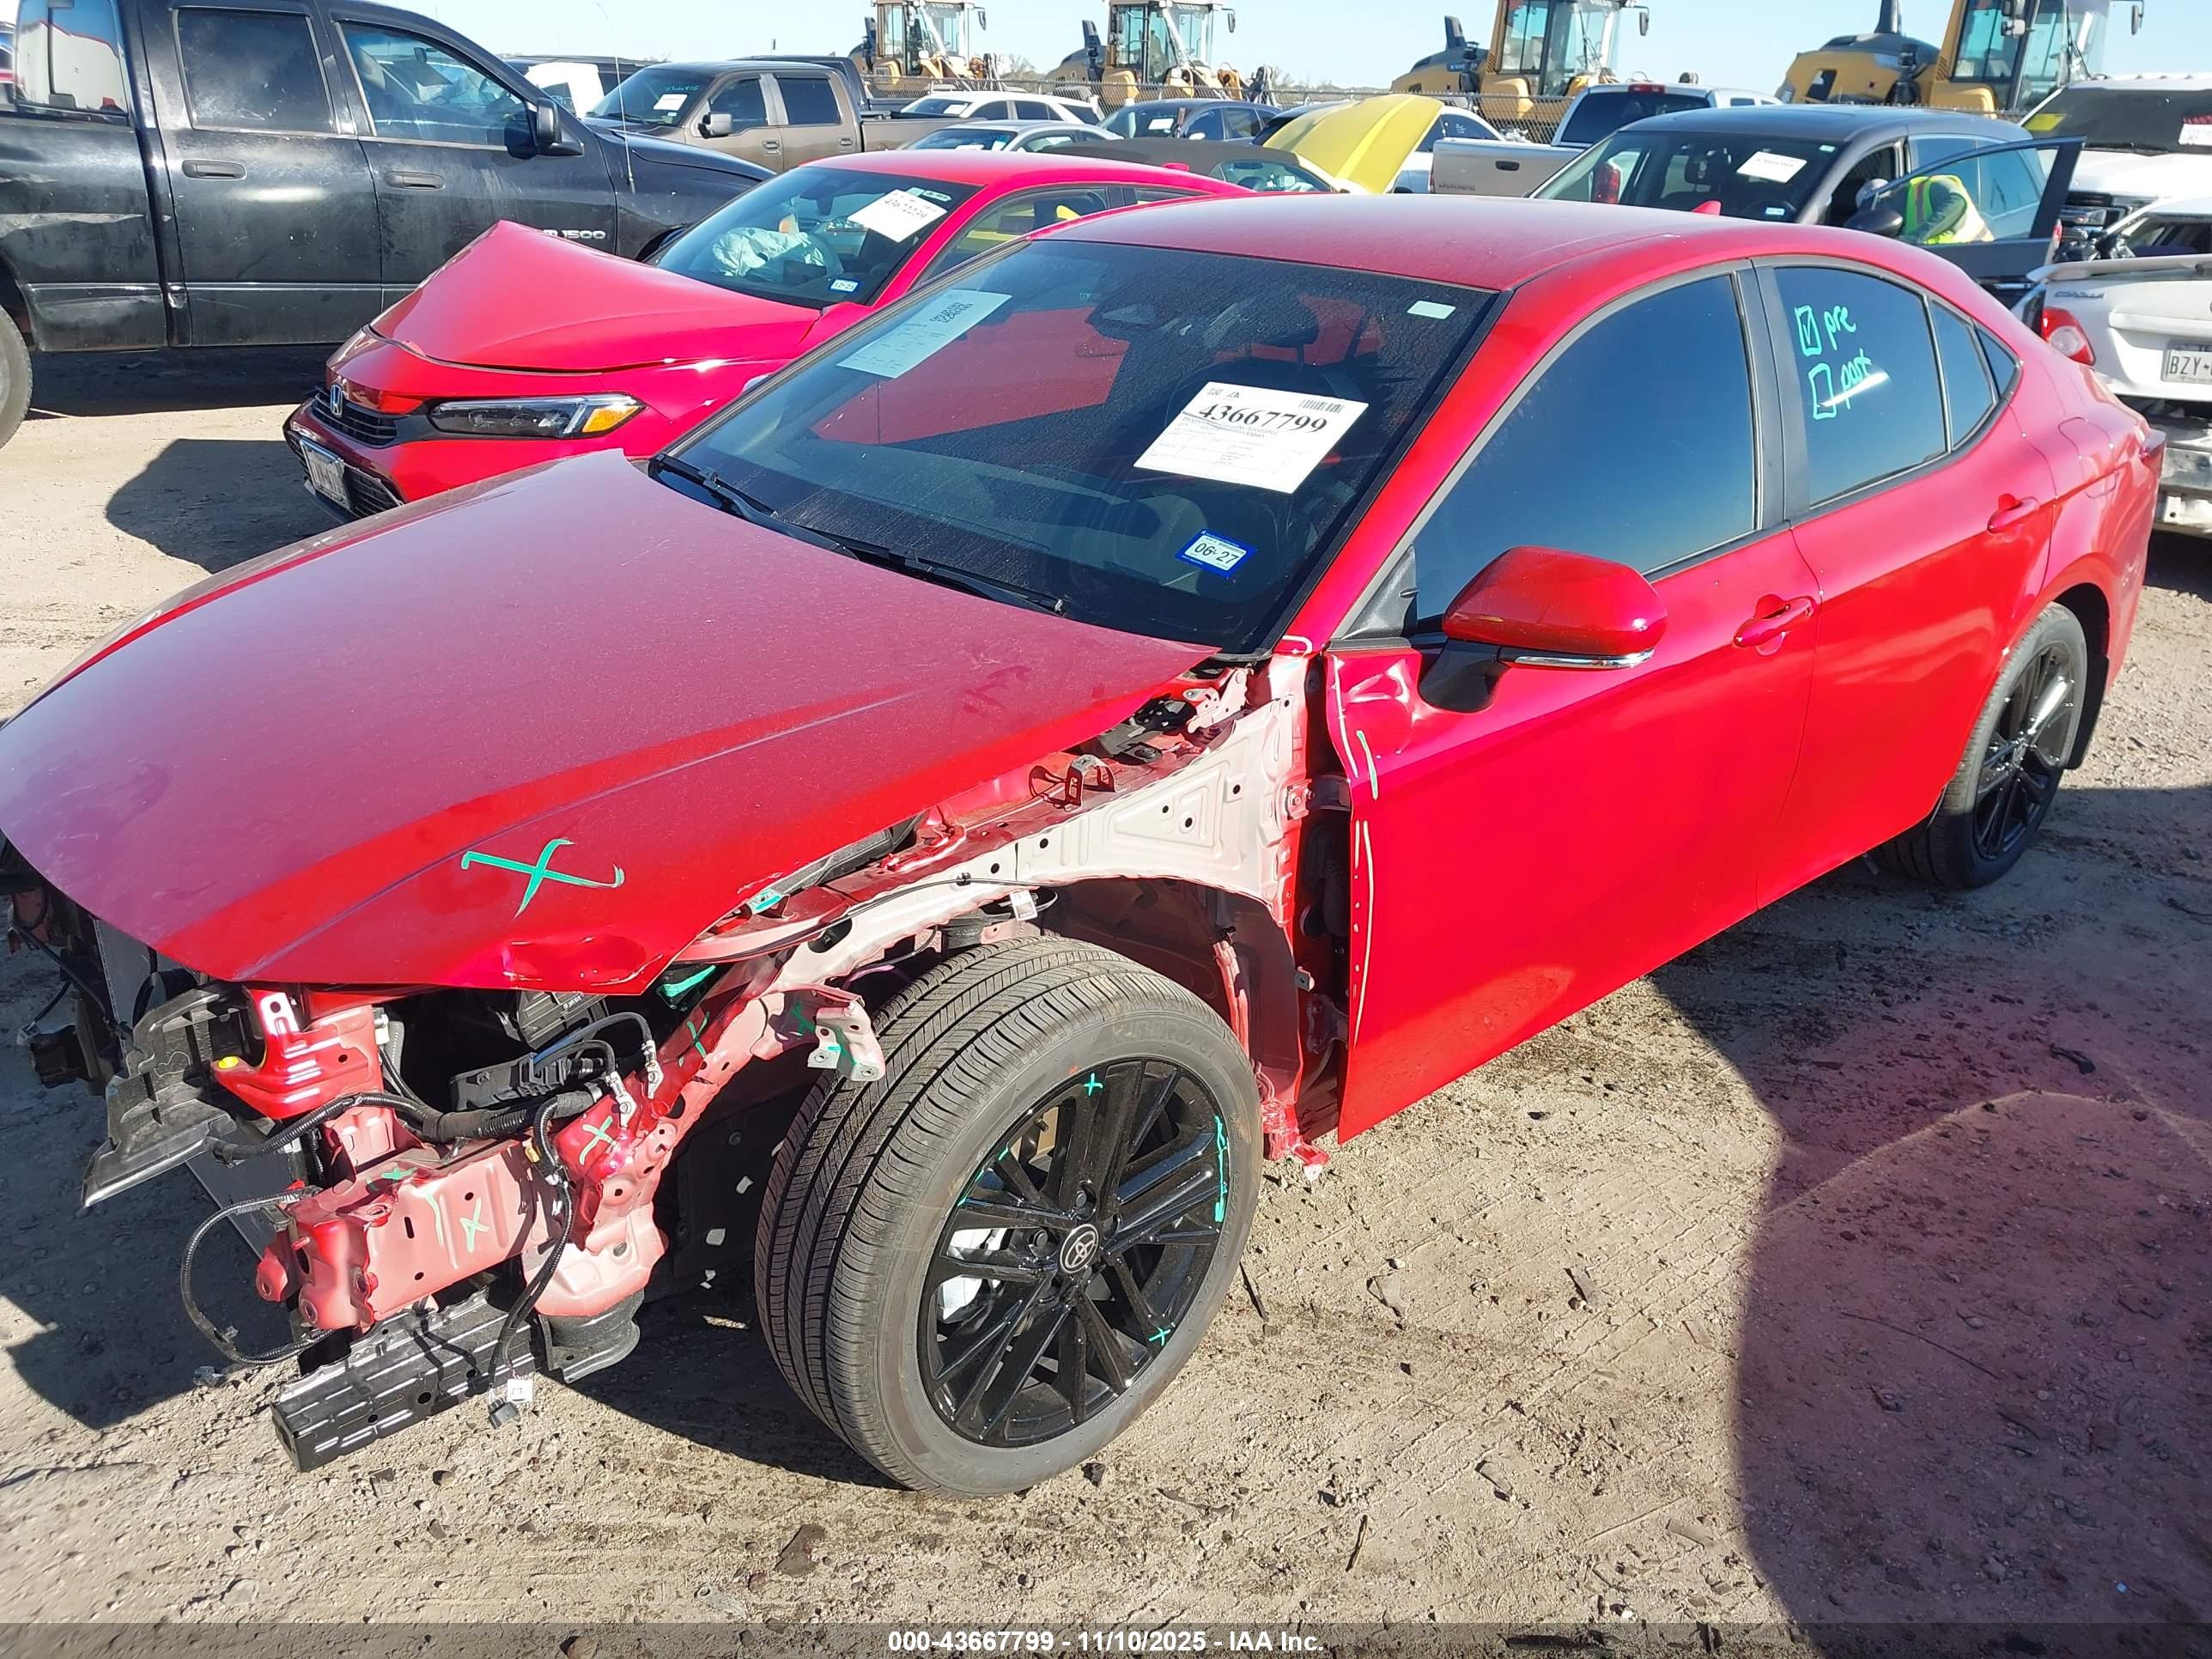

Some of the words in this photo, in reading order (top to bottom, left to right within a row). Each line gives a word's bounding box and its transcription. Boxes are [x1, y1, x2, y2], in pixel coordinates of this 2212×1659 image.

[562, 229, 606, 240] 1500
[1824, 305, 1856, 350] pre
[2170, 356, 2212, 375] BZY
[1199, 404, 1328, 433] 43667799
[1194, 543, 1215, 556] 06
[1216, 551, 1239, 564] 27
